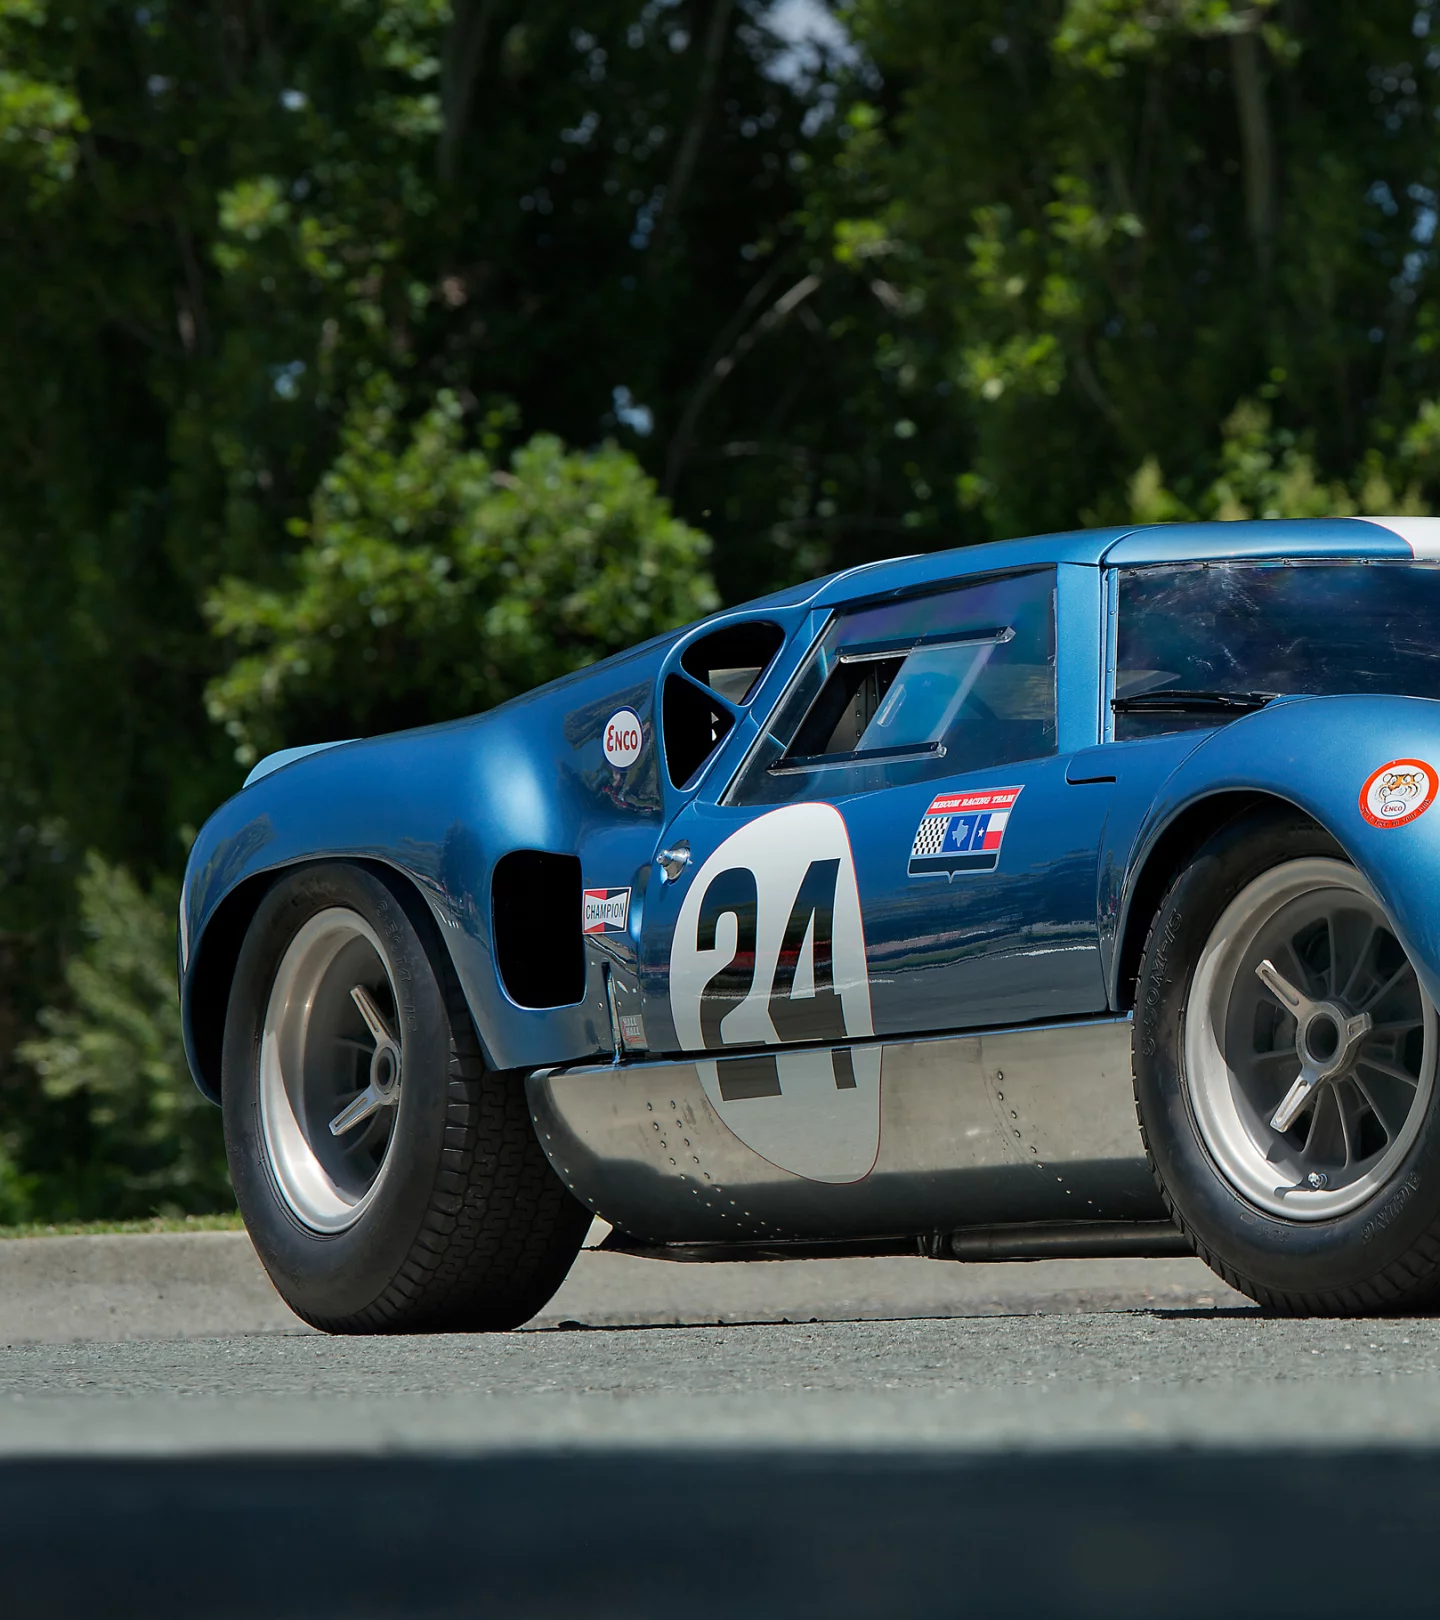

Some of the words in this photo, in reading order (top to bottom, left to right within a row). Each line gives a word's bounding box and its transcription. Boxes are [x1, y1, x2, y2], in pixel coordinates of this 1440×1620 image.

[607, 725, 638, 752] ENCO
[962, 797, 991, 806] RACING
[992, 795, 1015, 804] TEAM
[1383, 805, 1403, 813] ENCO
[585, 902, 625, 921] CHAMPION
[697, 857, 857, 1102] 24
